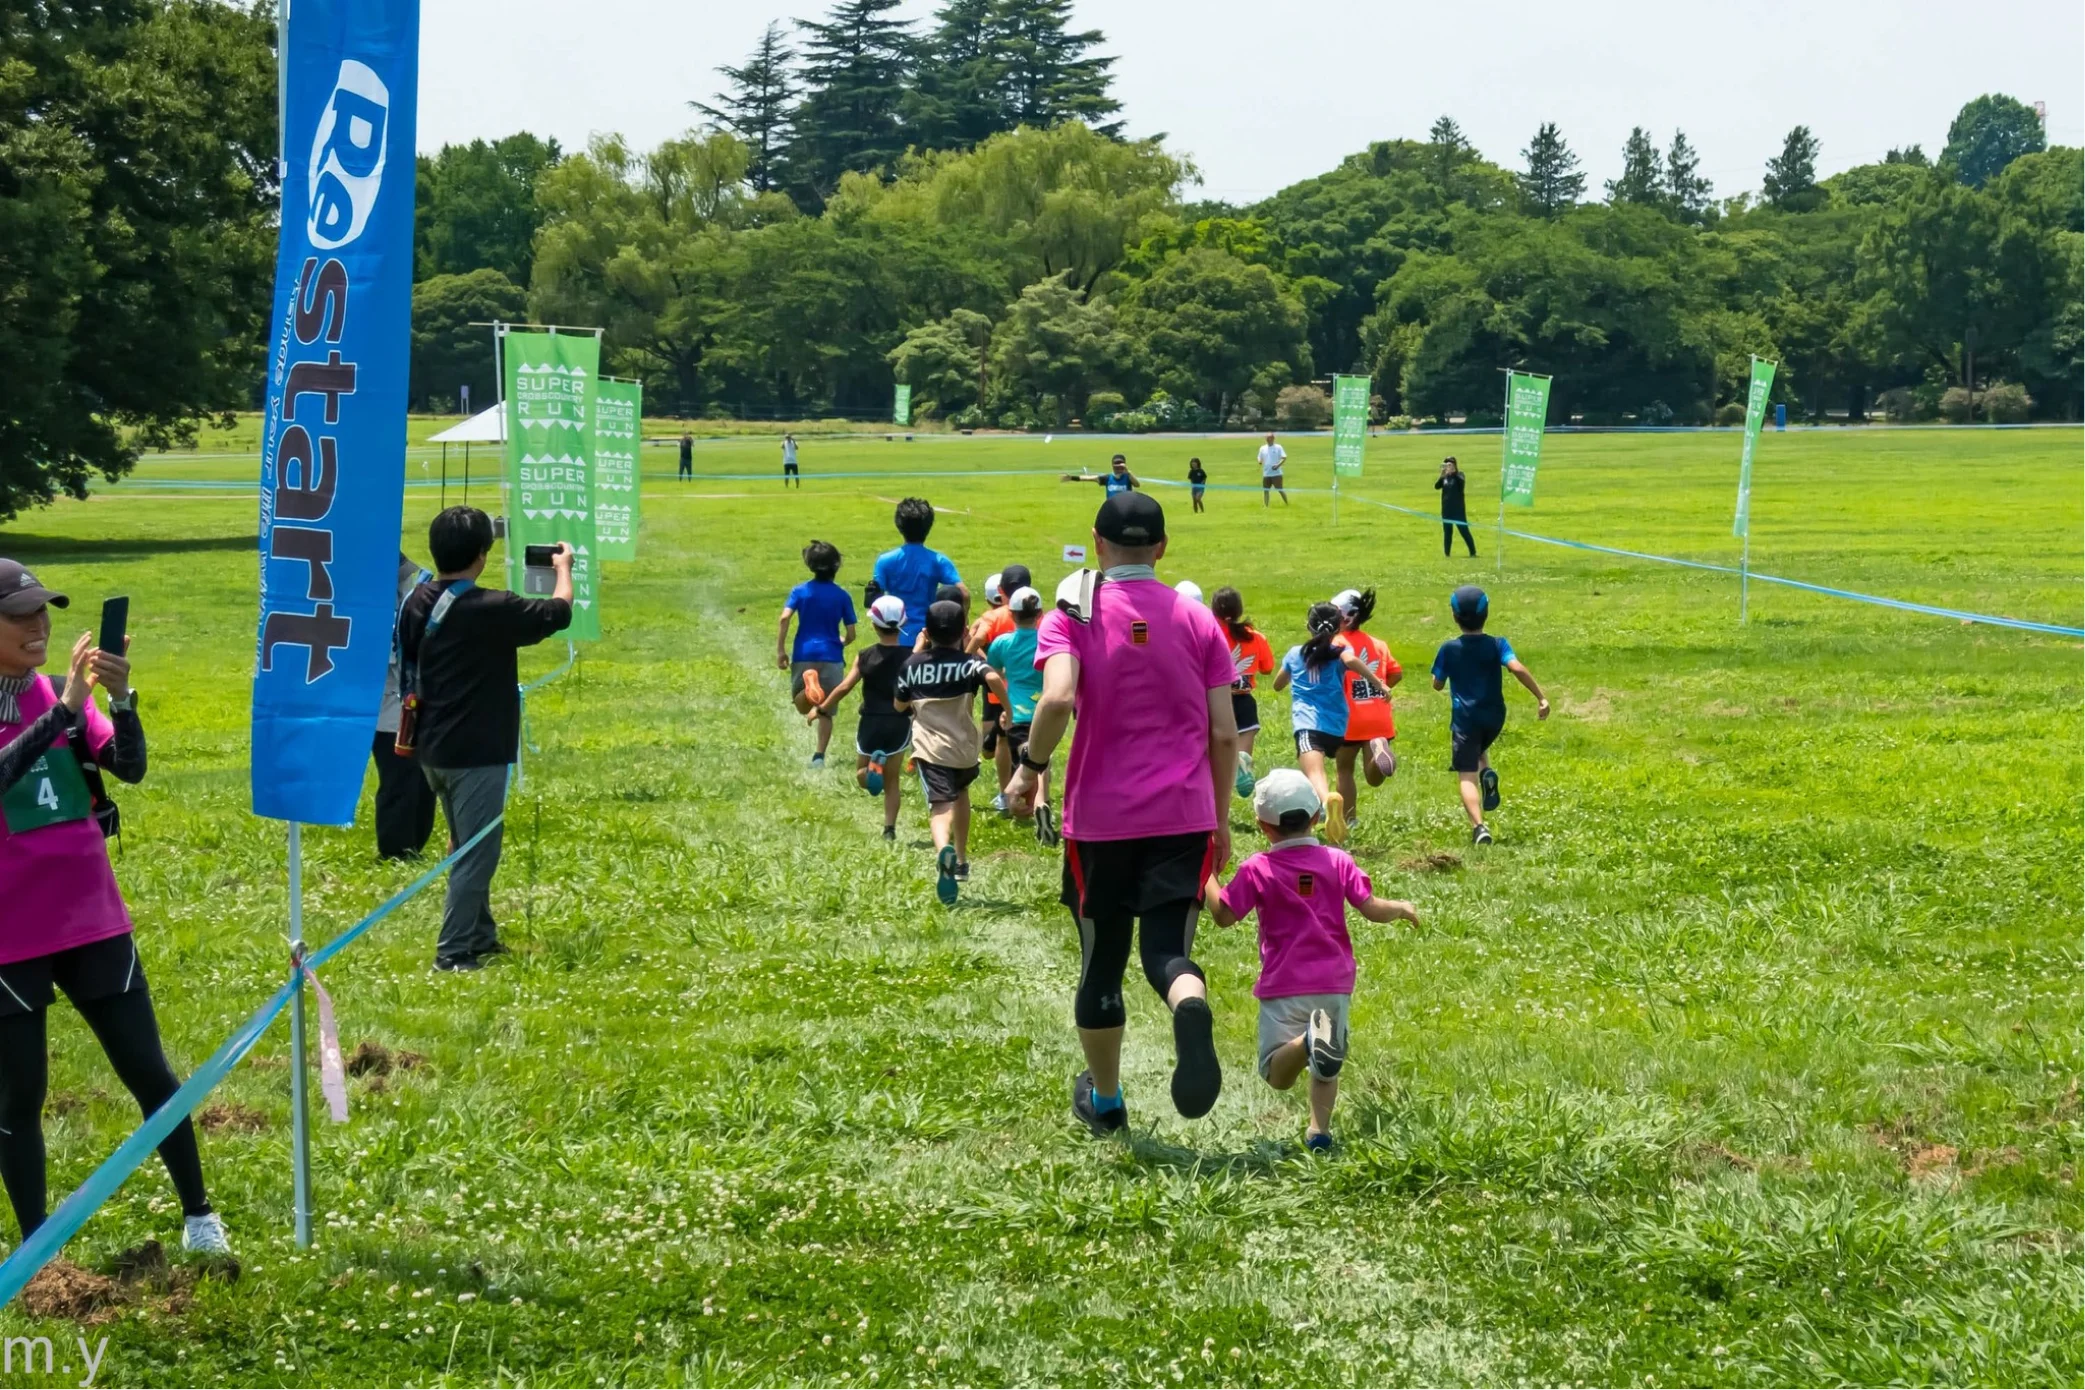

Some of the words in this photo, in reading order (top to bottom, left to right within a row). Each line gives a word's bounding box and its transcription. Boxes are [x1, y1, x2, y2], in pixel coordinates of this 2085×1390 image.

[517, 377, 584, 394] SUPER
[518, 402, 585, 418] RUN
[597, 459, 632, 470] UPER
[520, 467, 585, 483] SUPER
[522, 492, 587, 508] RUN
[595, 511, 630, 521] UPER
[38, 777, 58, 810] 4
